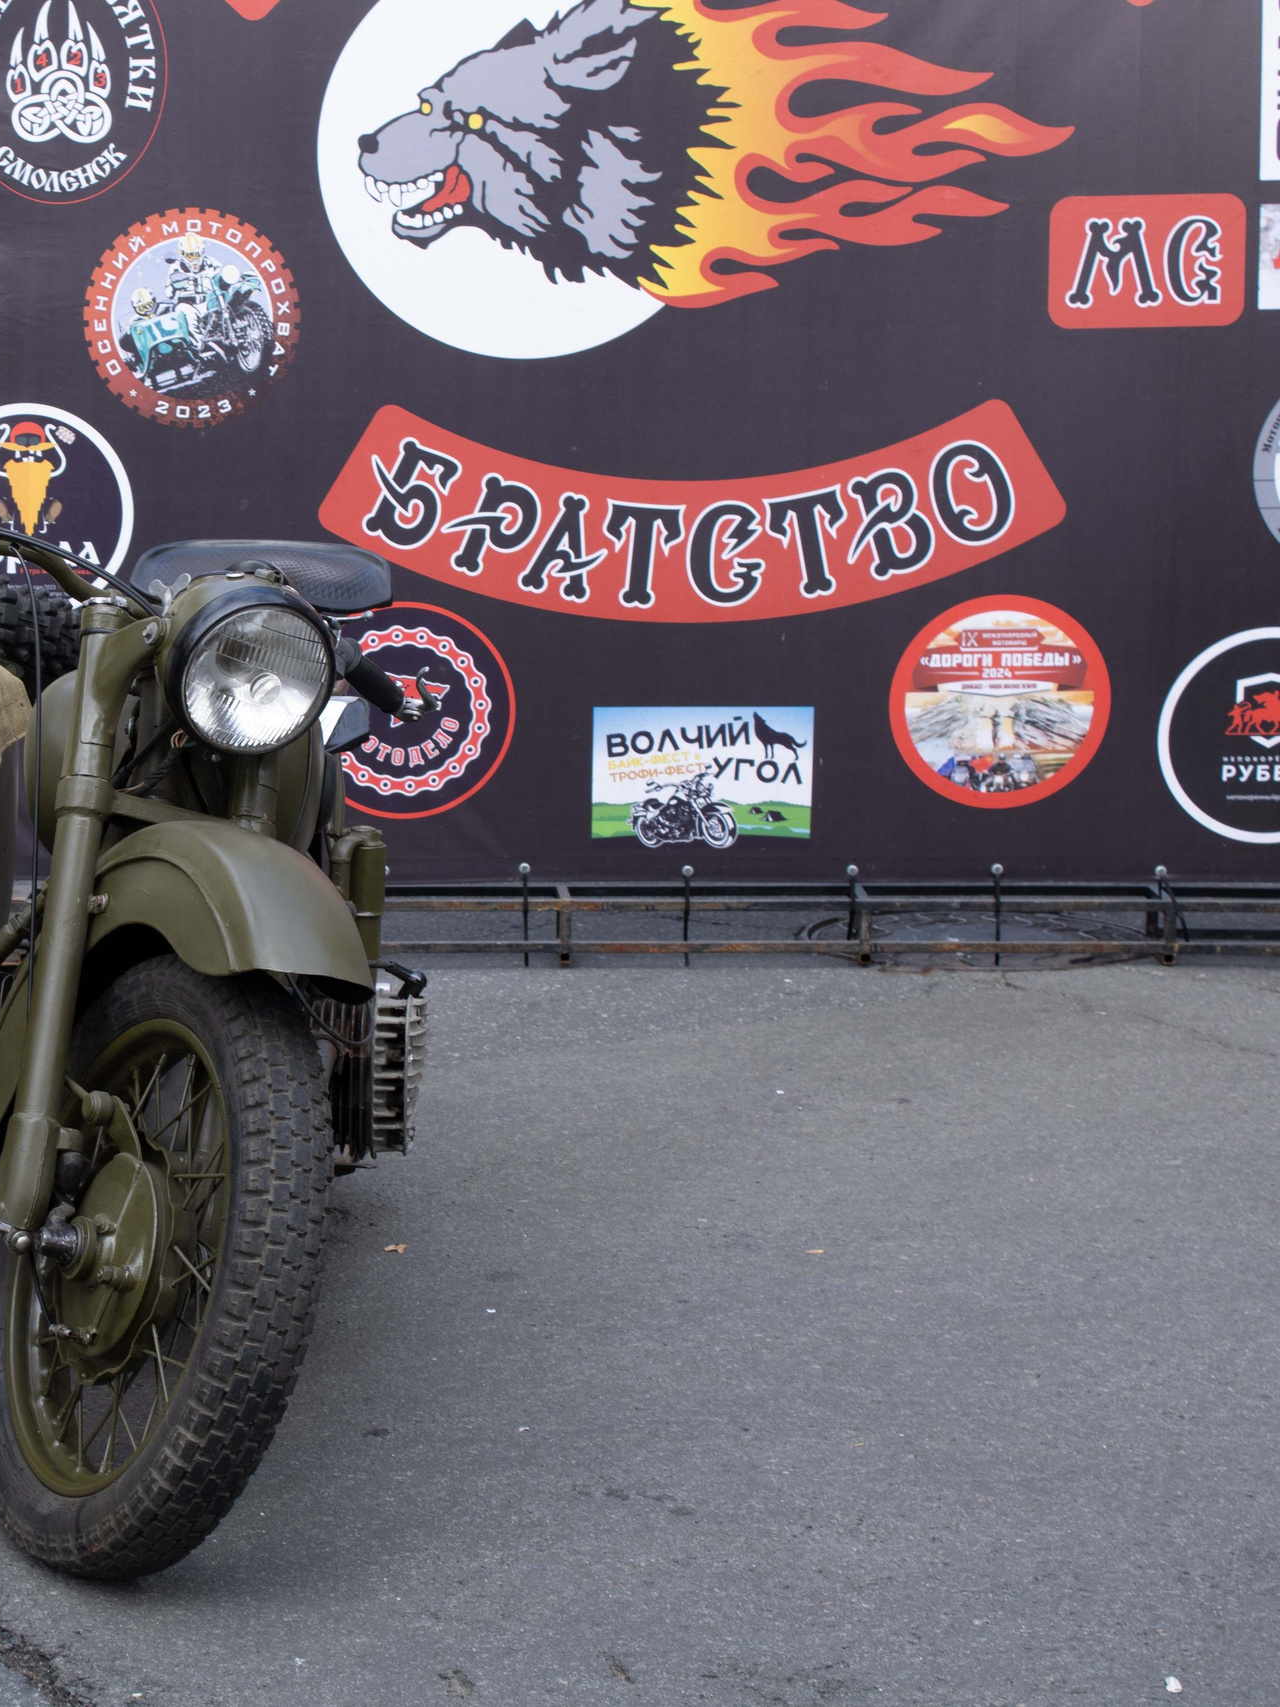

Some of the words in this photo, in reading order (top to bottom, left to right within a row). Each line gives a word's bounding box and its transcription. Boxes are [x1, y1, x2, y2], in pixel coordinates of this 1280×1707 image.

[35, 52, 49, 67] 4
[69, 51, 83, 66] 2
[13, 77, 24, 94] 1
[93, 72, 107, 88] 3
[93, 235, 146, 377] ОСЕННИЙ
[161, 218, 291, 377] МОТОПРОХВАТ
[154, 398, 233, 420] 2023
[363, 436, 1017, 608] БРАТСТВО
[961, 631, 979, 648] IX
[920, 653, 993, 668] «ДОРОГИ
[981, 667, 1013, 679] 2024
[360, 716, 461, 768] ОТОДЕЛО
[606, 715, 751, 758] ВОЛЧИЙ
[607, 750, 691, 771] БАЙК-ФЕСТ
[712, 756, 803, 785] УГОЛ
[609, 762, 705, 782] ТРОФИ-ФЕСТ
